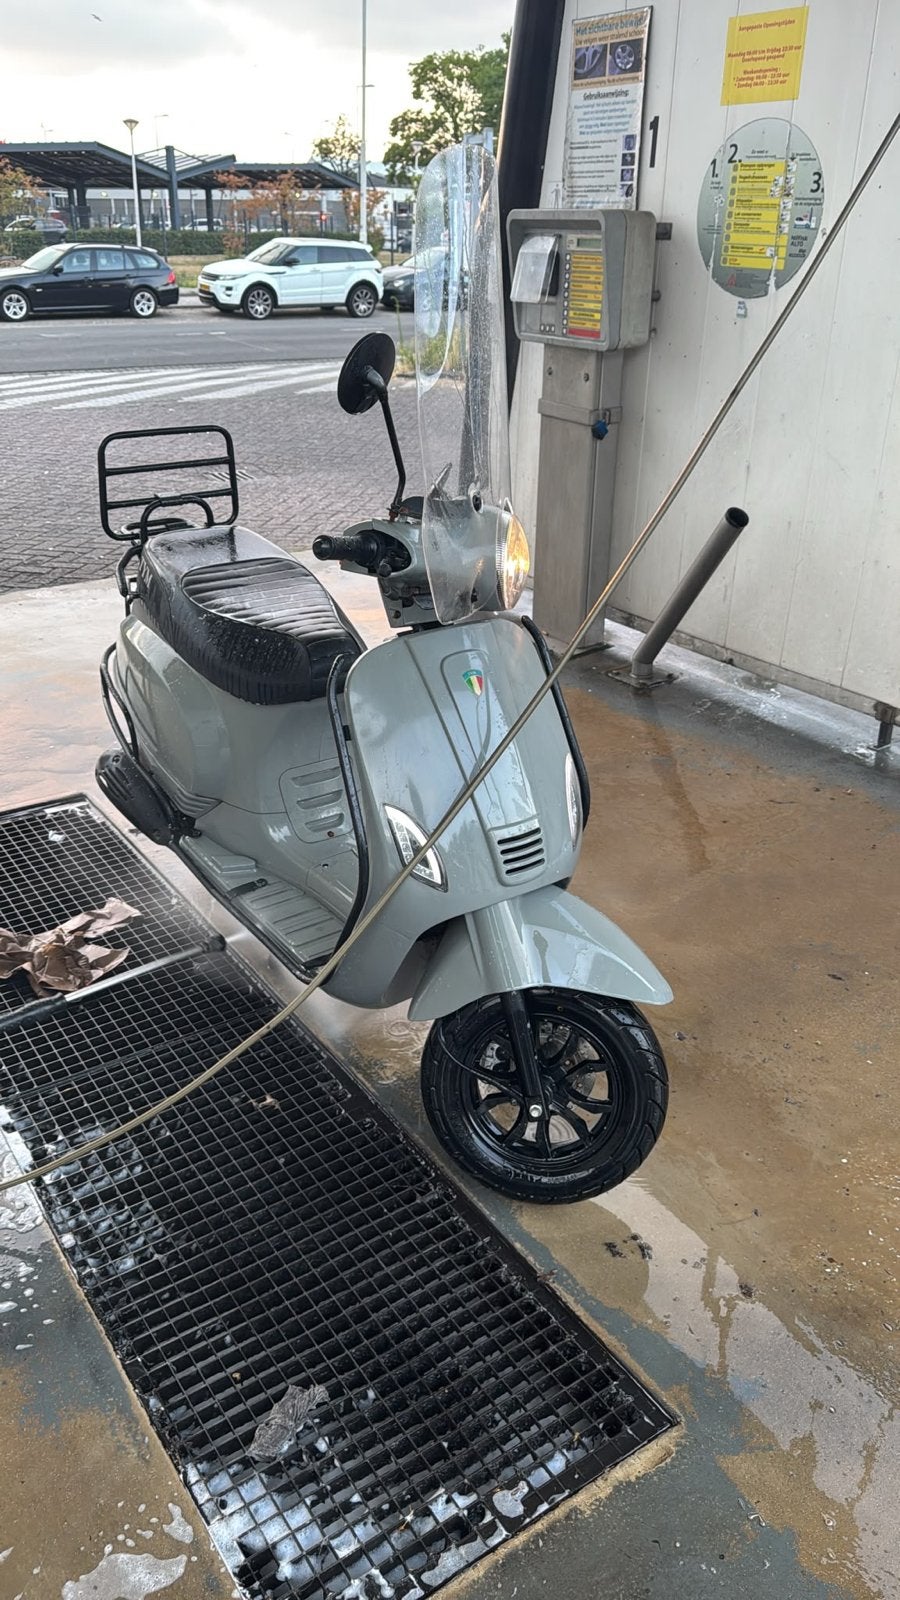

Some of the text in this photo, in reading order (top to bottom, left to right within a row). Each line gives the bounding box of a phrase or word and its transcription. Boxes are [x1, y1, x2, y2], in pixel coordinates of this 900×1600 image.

[610, 32, 628, 41] stralend
[649, 115, 660, 168] 1
[727, 143, 742, 164] 2.
[710, 158, 719, 178] 1.
[810, 171, 824, 193] 3.
